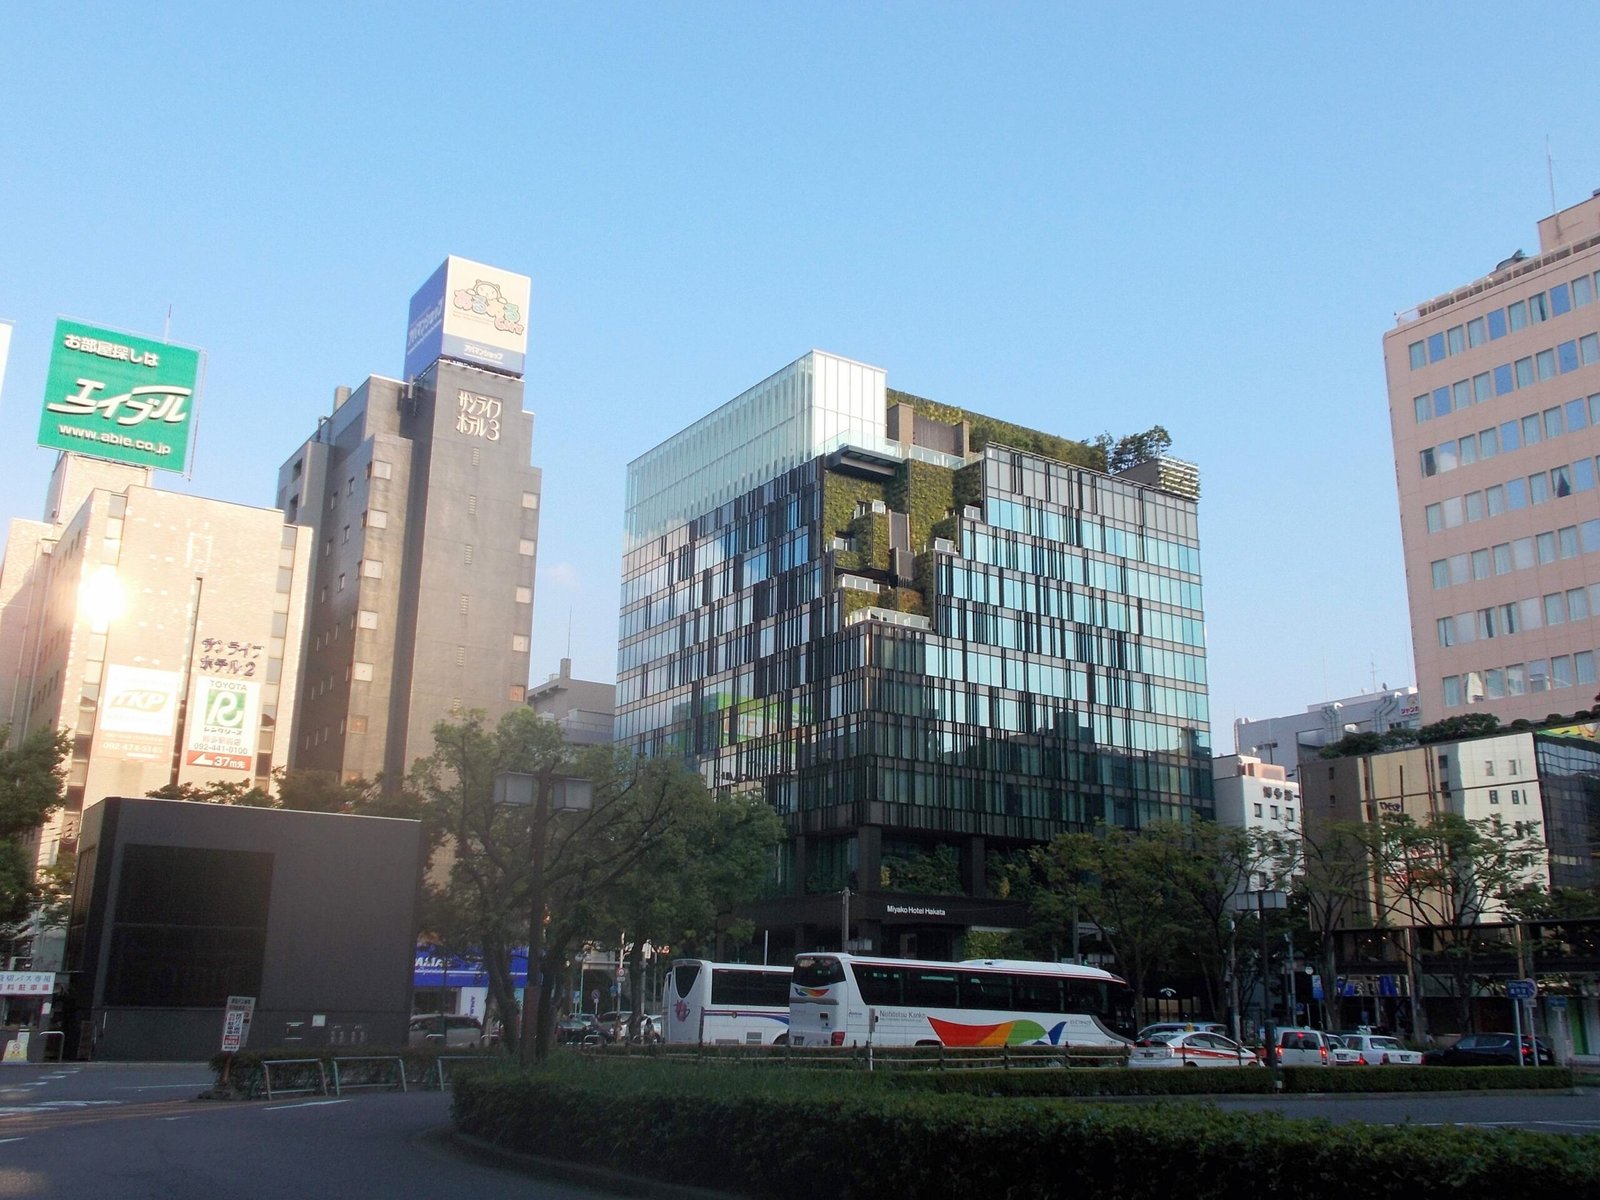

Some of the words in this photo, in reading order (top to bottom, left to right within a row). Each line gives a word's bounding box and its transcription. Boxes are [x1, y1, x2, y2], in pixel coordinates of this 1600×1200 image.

[65, 334, 159, 367] お部屋探しは
[47, 378, 192, 426] エイブル
[458, 391, 502, 419] サンライフ
[58, 423, 171, 456] www.able.co.jp
[456, 414, 500, 441] ホテル3
[201, 637, 264, 659] サンライフ
[200, 655, 256, 677] ホテル2
[210, 679, 247, 691] TOYOTA
[194, 742, 248, 755] 092-441-0100
[887, 905, 908, 914] Miyako
[908, 906, 924, 914] Hotel
[925, 908, 946, 916] Hakata
